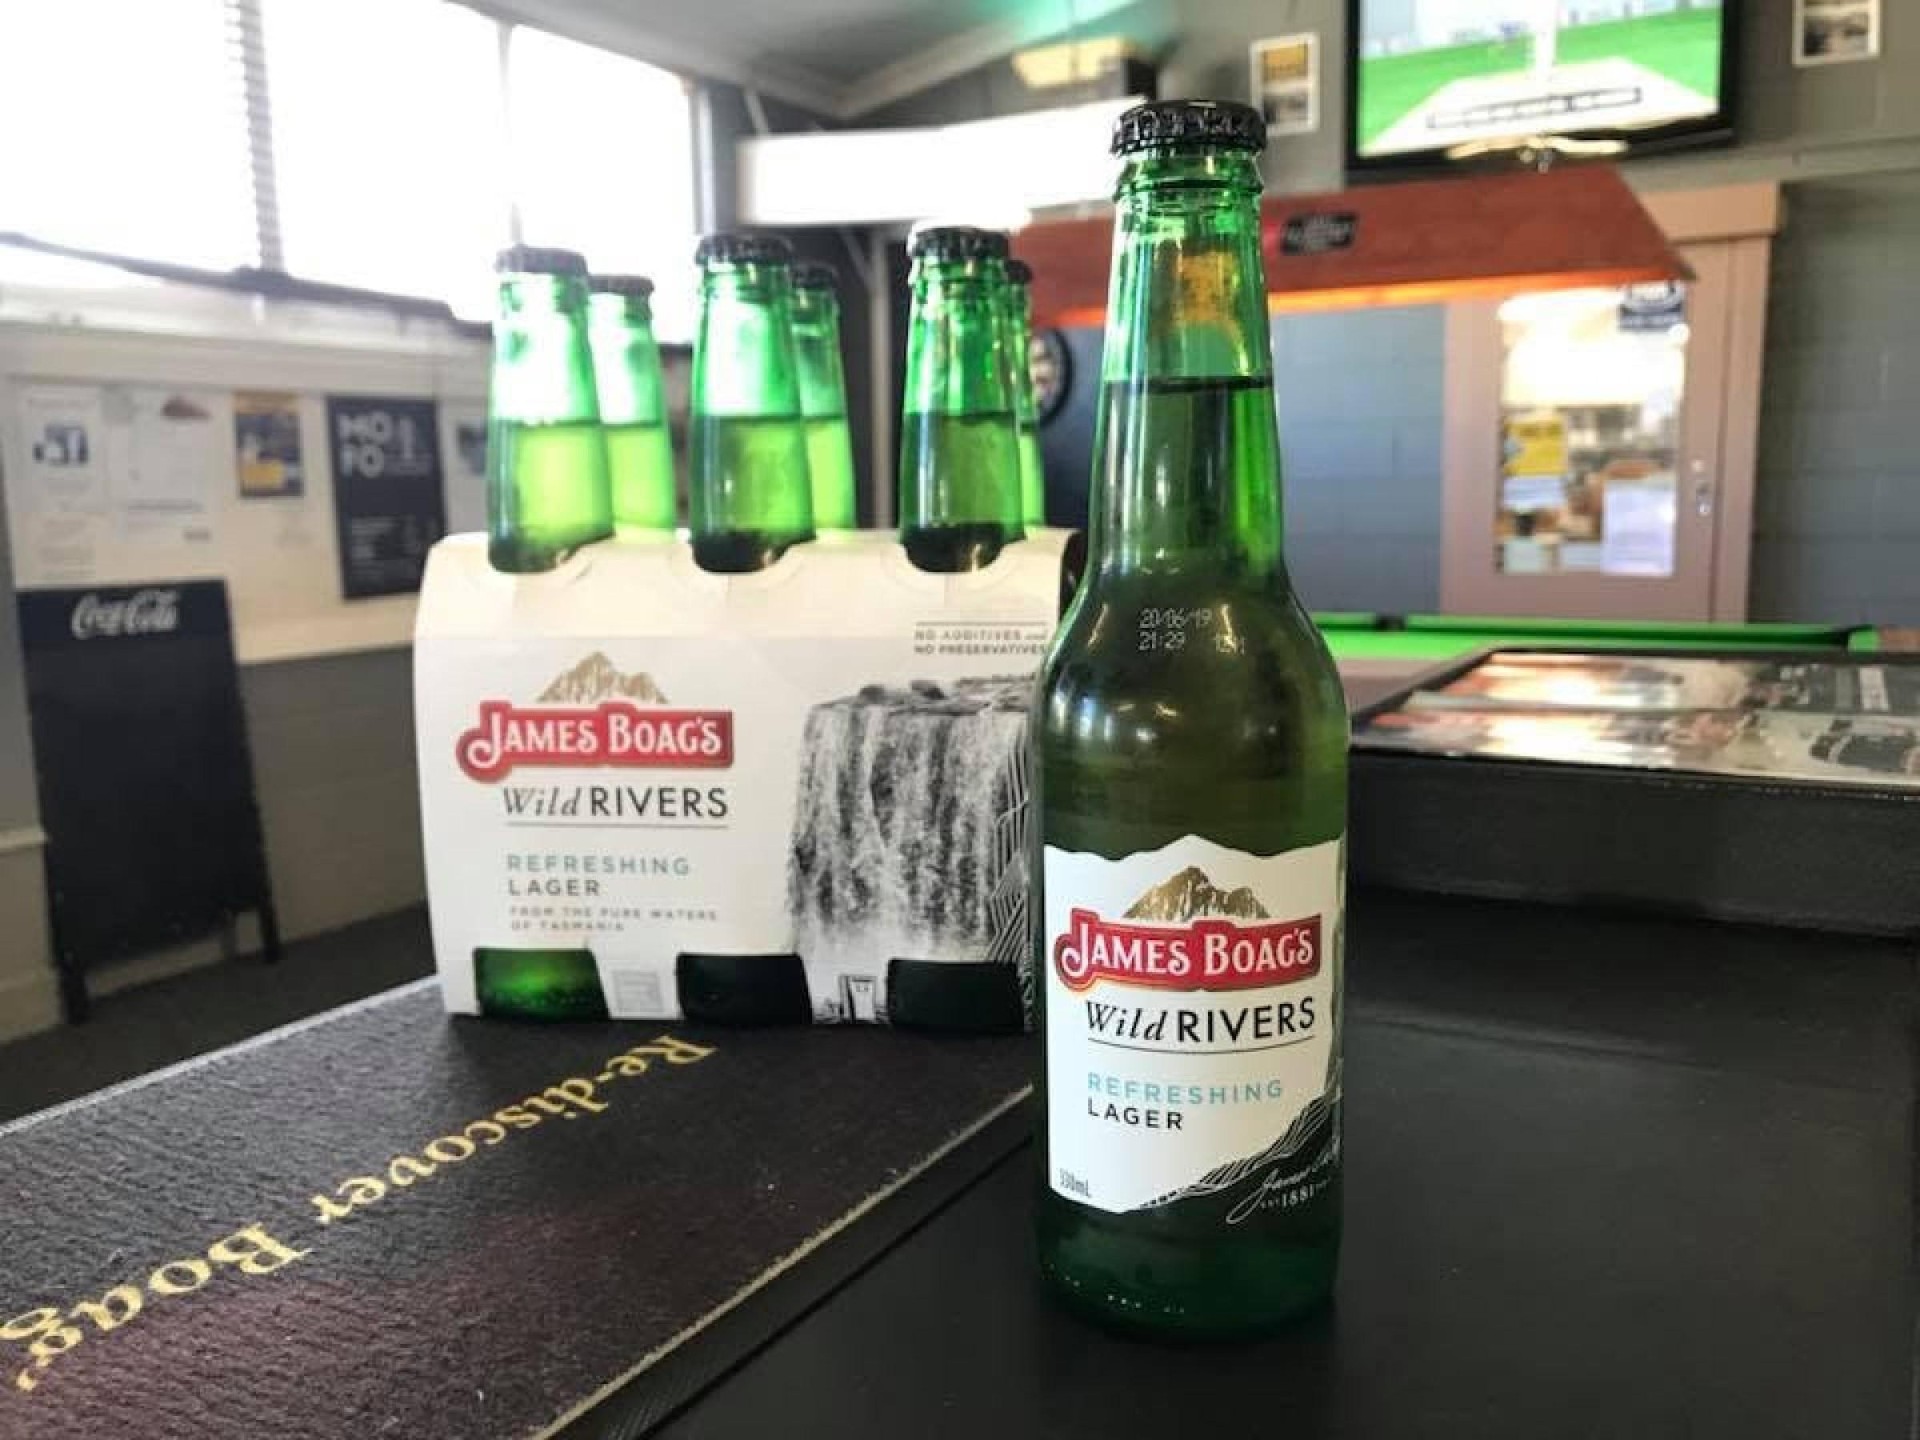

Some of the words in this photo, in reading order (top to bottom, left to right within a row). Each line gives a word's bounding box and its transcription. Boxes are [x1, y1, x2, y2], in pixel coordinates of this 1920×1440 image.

[467, 711, 599, 769] JAMES
[607, 713, 722, 756] BOAG'S
[502, 786, 582, 818] Wild
[591, 786, 729, 818] RIVERS
[507, 854, 690, 876] REFRESHING
[508, 879, 601, 898] LAGER
[1060, 921, 1192, 977] JAMES
[1203, 927, 1314, 977] BOAG'S
[1086, 999, 1169, 1042] Wild
[1177, 997, 1316, 1044] RIVERS
[1087, 1072, 1283, 1103] REFRESHING
[310, 1034, 719, 1226] Re-discover
[1087, 1098, 1185, 1131] LAGER
